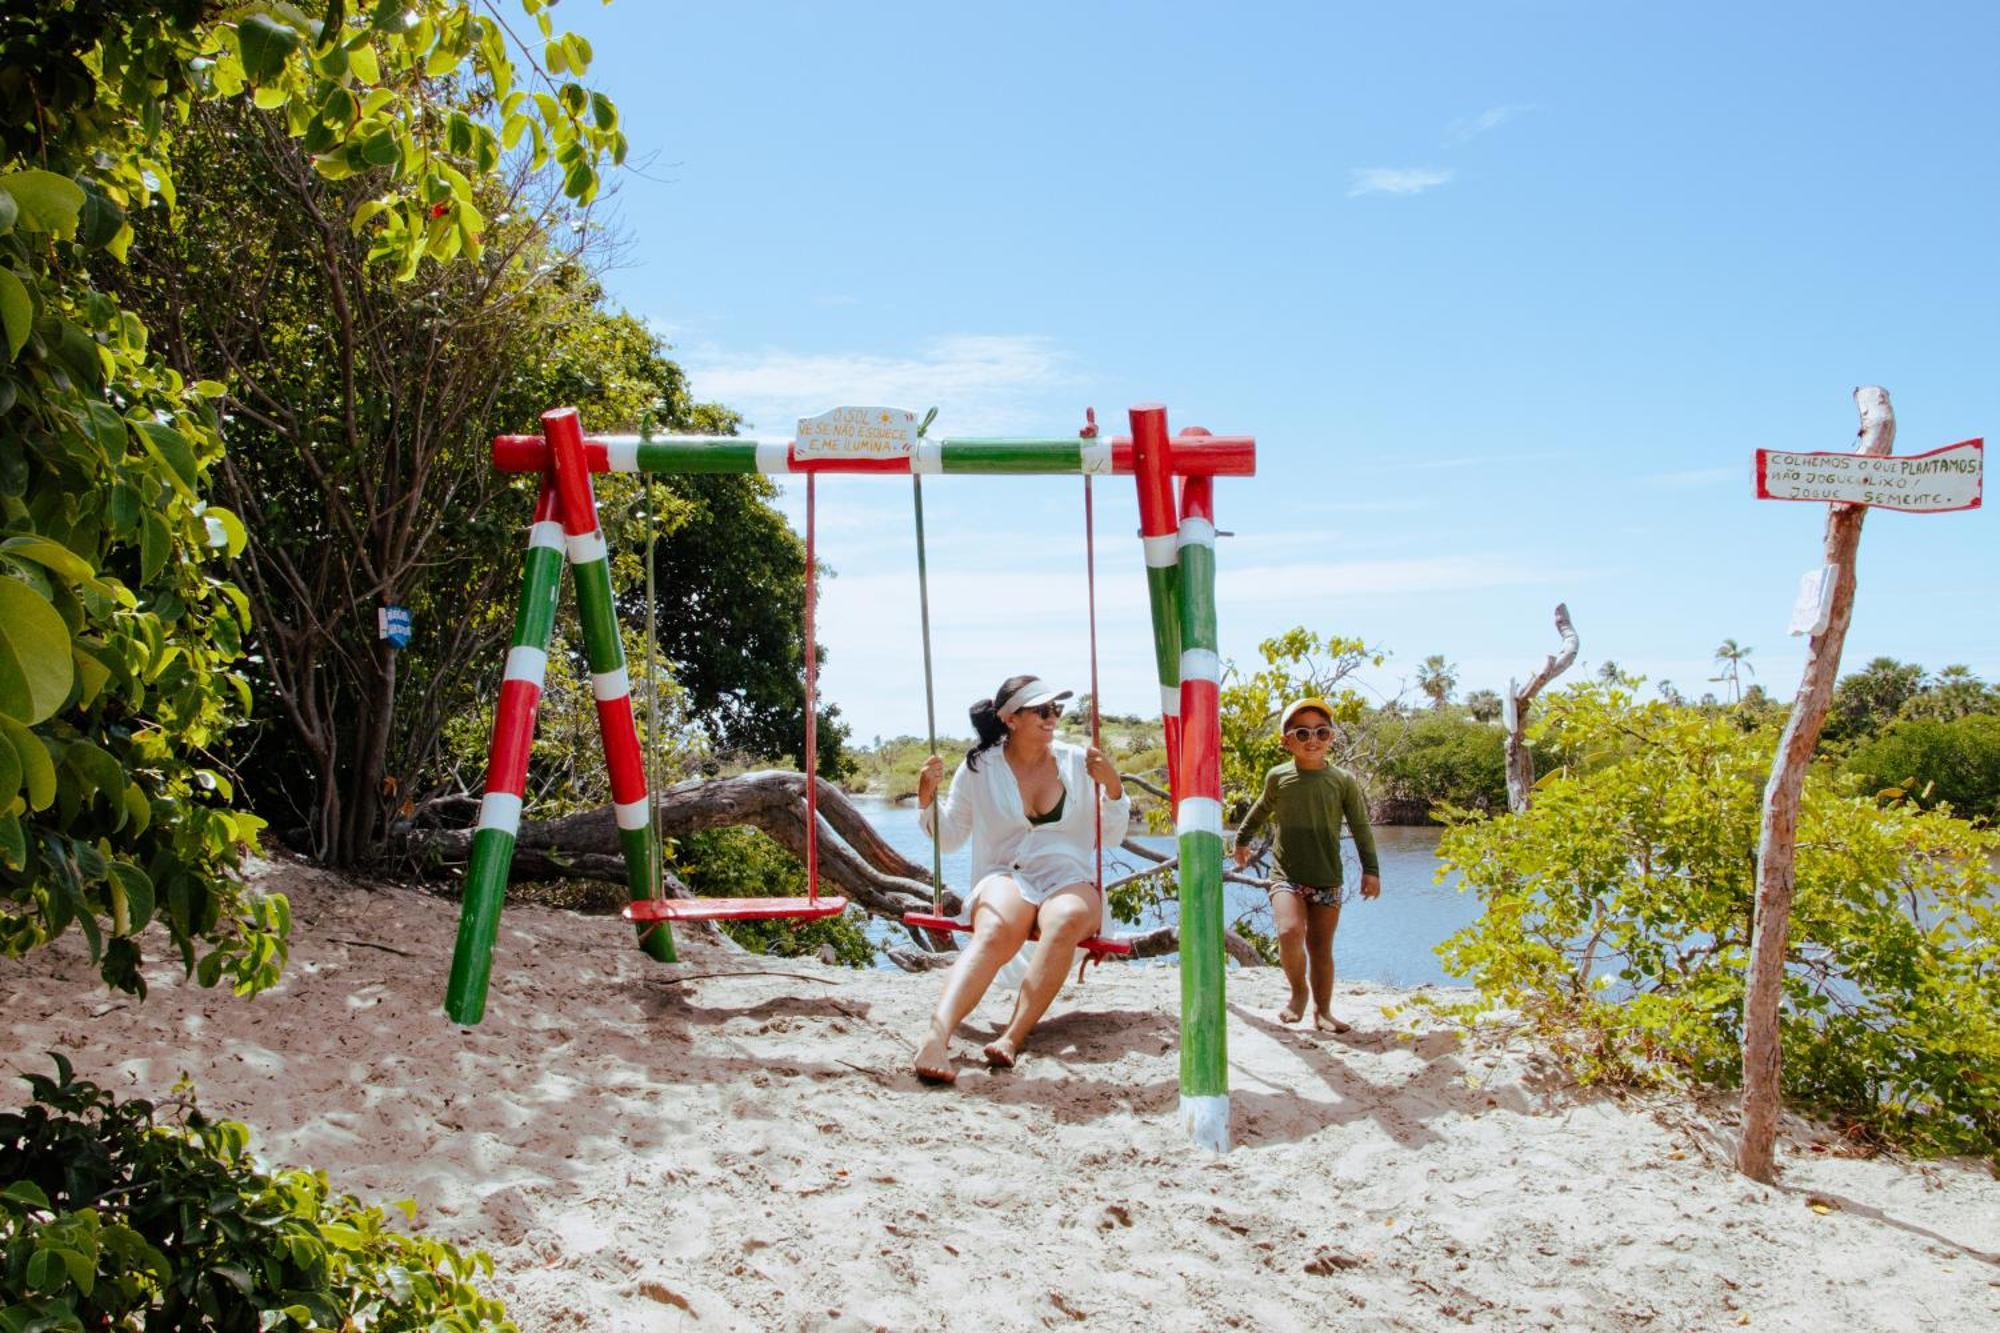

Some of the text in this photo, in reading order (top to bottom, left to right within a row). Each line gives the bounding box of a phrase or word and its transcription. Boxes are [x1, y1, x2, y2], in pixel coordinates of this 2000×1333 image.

[1771, 454, 1852, 470] COLHEMOS
[1858, 460, 1868, 470] O
[1772, 468, 1801, 481] NÃO
[1806, 472, 1856, 485] JOGUE
